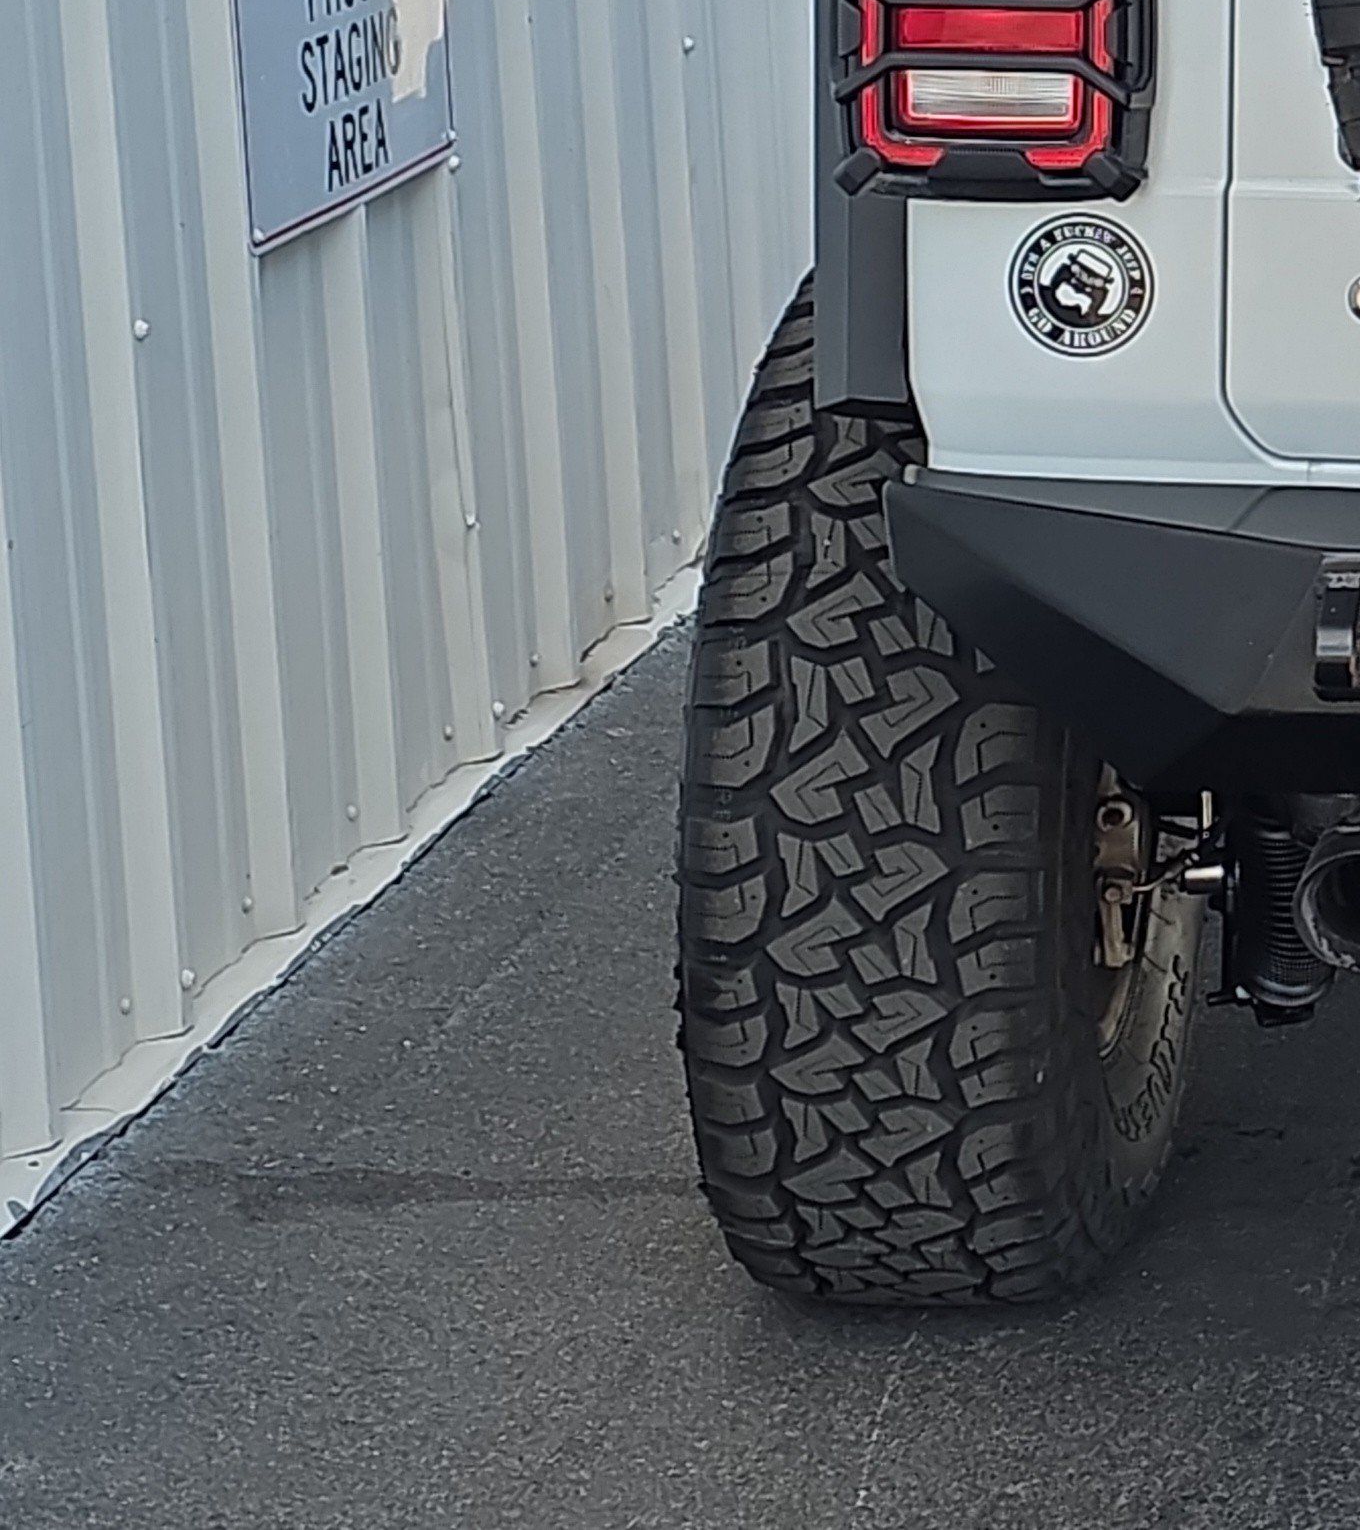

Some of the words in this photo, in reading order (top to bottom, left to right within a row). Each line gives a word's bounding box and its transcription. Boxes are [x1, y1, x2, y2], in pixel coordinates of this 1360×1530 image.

[300, 8, 399, 114] STAGING
[327, 101, 389, 191] AREA
[1028, 307, 1053, 333] GO
[1057, 308, 1137, 348] AROUND
